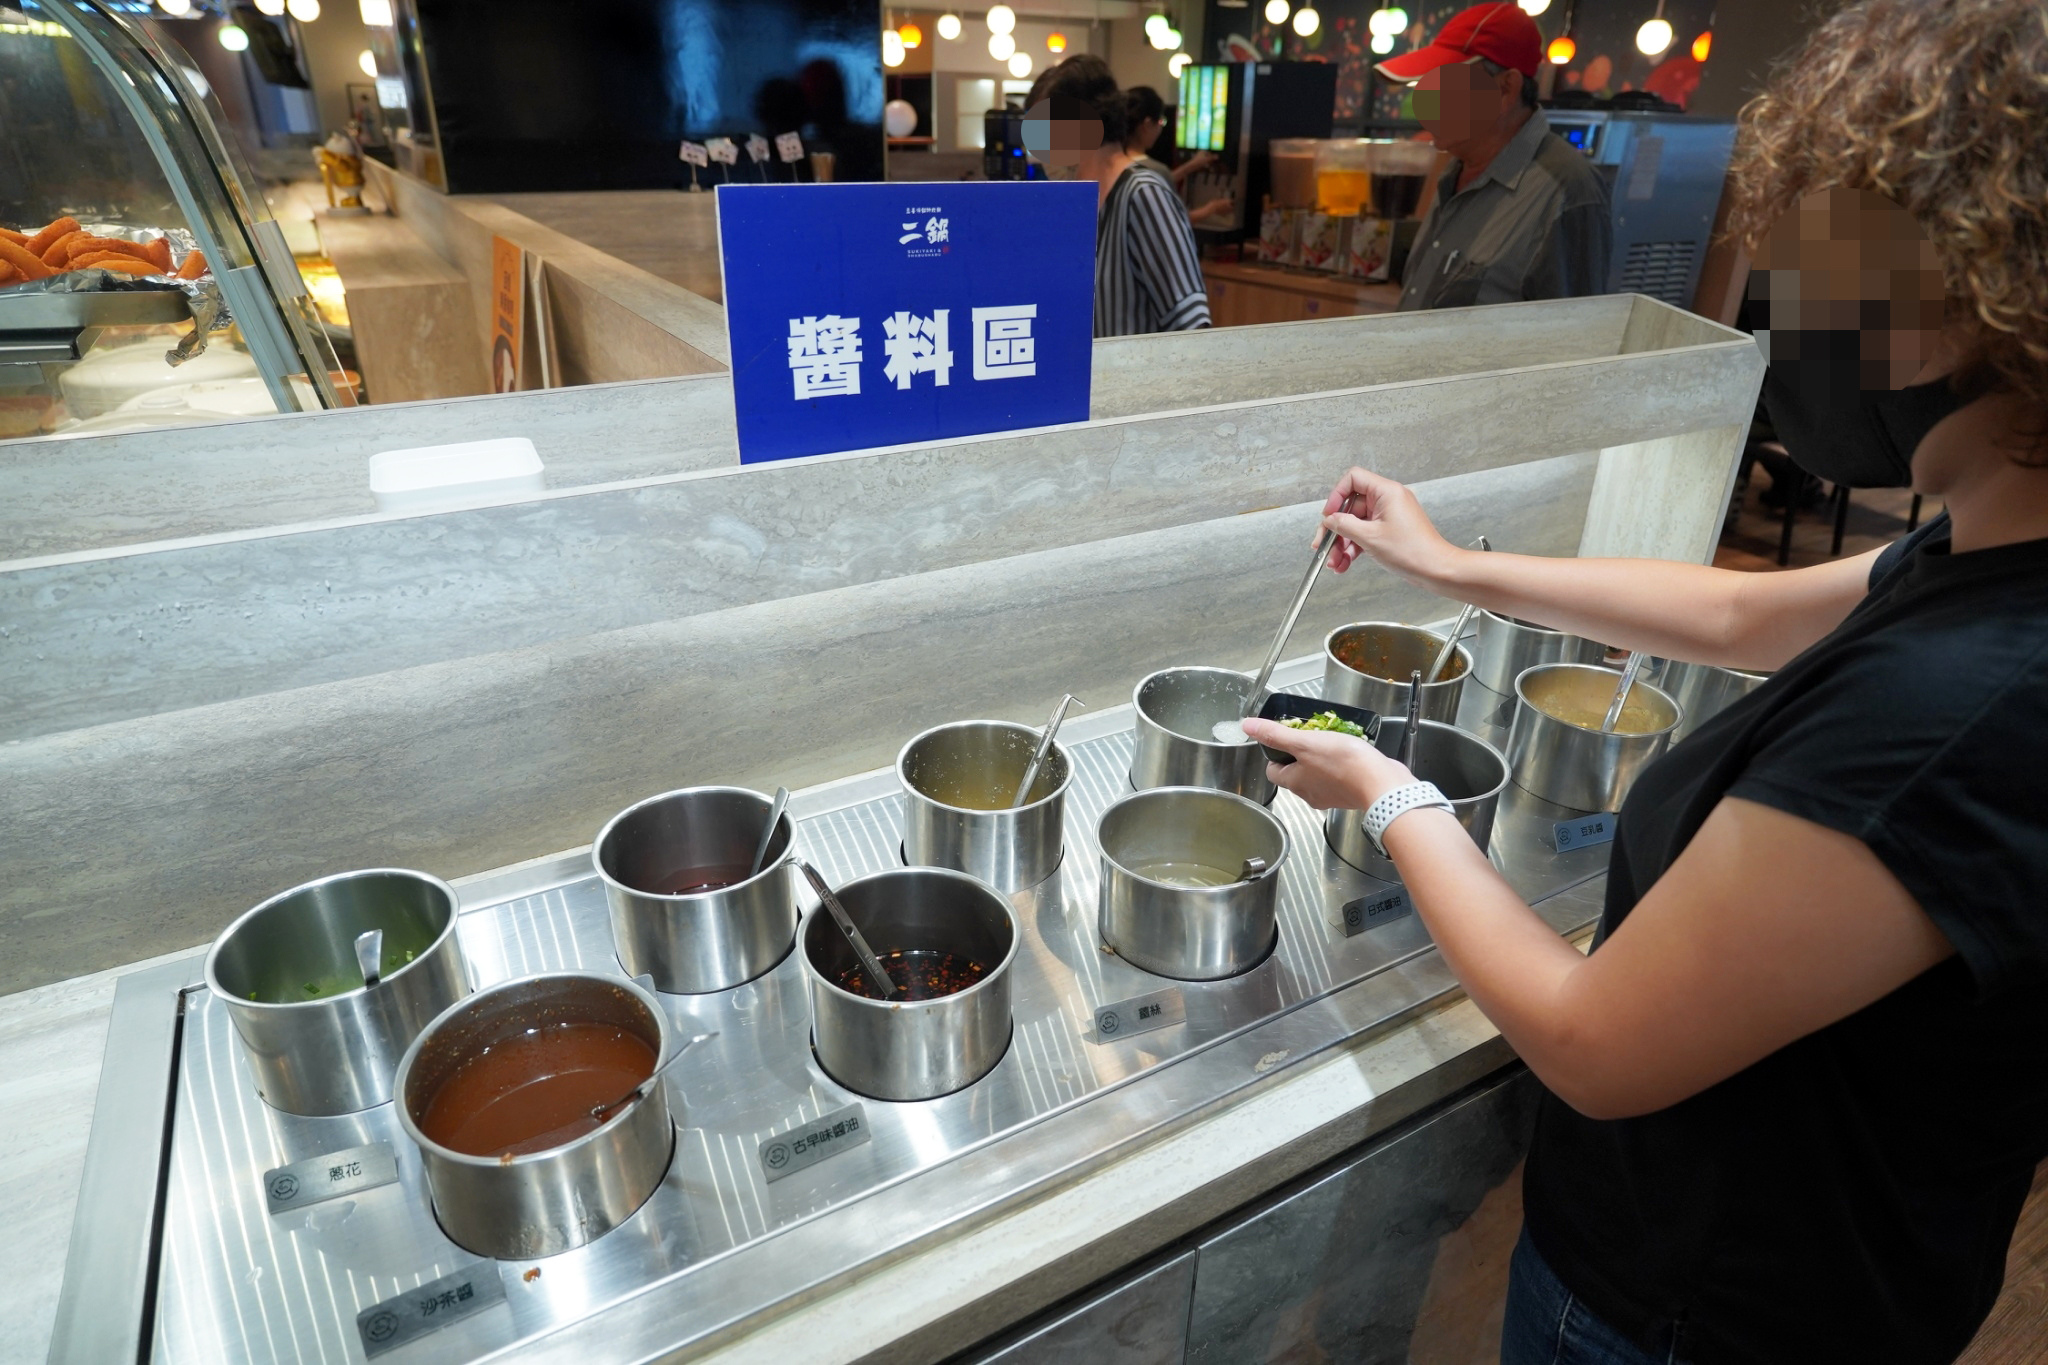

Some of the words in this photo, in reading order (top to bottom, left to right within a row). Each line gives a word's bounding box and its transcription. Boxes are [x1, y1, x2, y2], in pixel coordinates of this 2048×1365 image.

[899, 216, 949, 245] 二鍋
[787, 304, 1037, 401] 醬料區
[1368, 896, 1402, 916] 日式醬油
[792, 1117, 860, 1155] 古早味醬油
[329, 1161, 362, 1183] 蔥花
[420, 1281, 475, 1317] 沙茶醬
